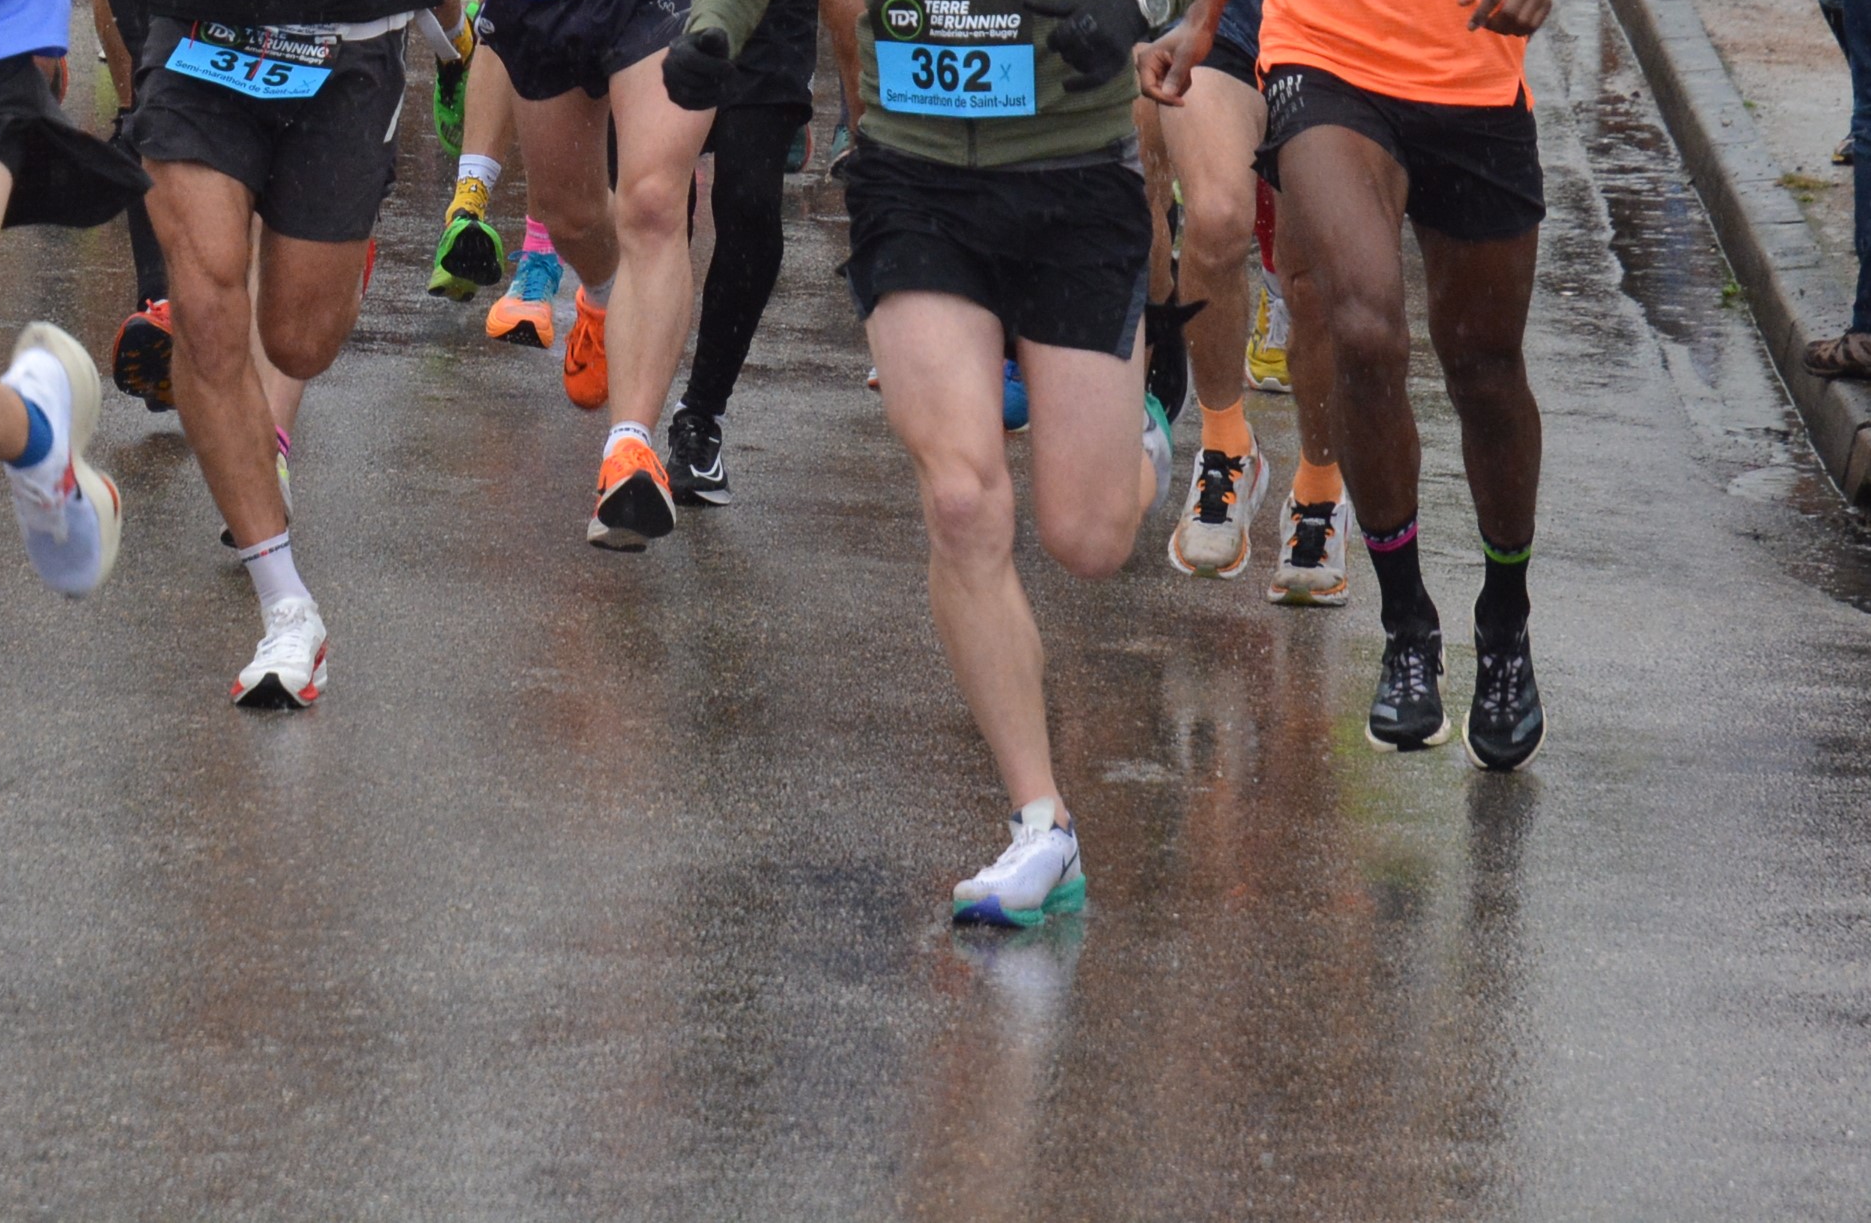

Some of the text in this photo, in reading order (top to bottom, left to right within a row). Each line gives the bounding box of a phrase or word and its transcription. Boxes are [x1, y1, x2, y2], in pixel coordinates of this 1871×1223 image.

[924, 0, 970, 14] TERRE
[888, 9, 918, 27] TDR
[930, 13, 1021, 29] DE RUNNING
[207, 22, 236, 43] TDR
[929, 28, 1019, 39] Ambérieu-en-Bugey
[175, 59, 311, 95] Semi-marathon de Saint-Just
[210, 50, 294, 87] 315
[911, 47, 992, 92] 362
[886, 89, 1026, 108] Semi-marathon de Saint-Just
